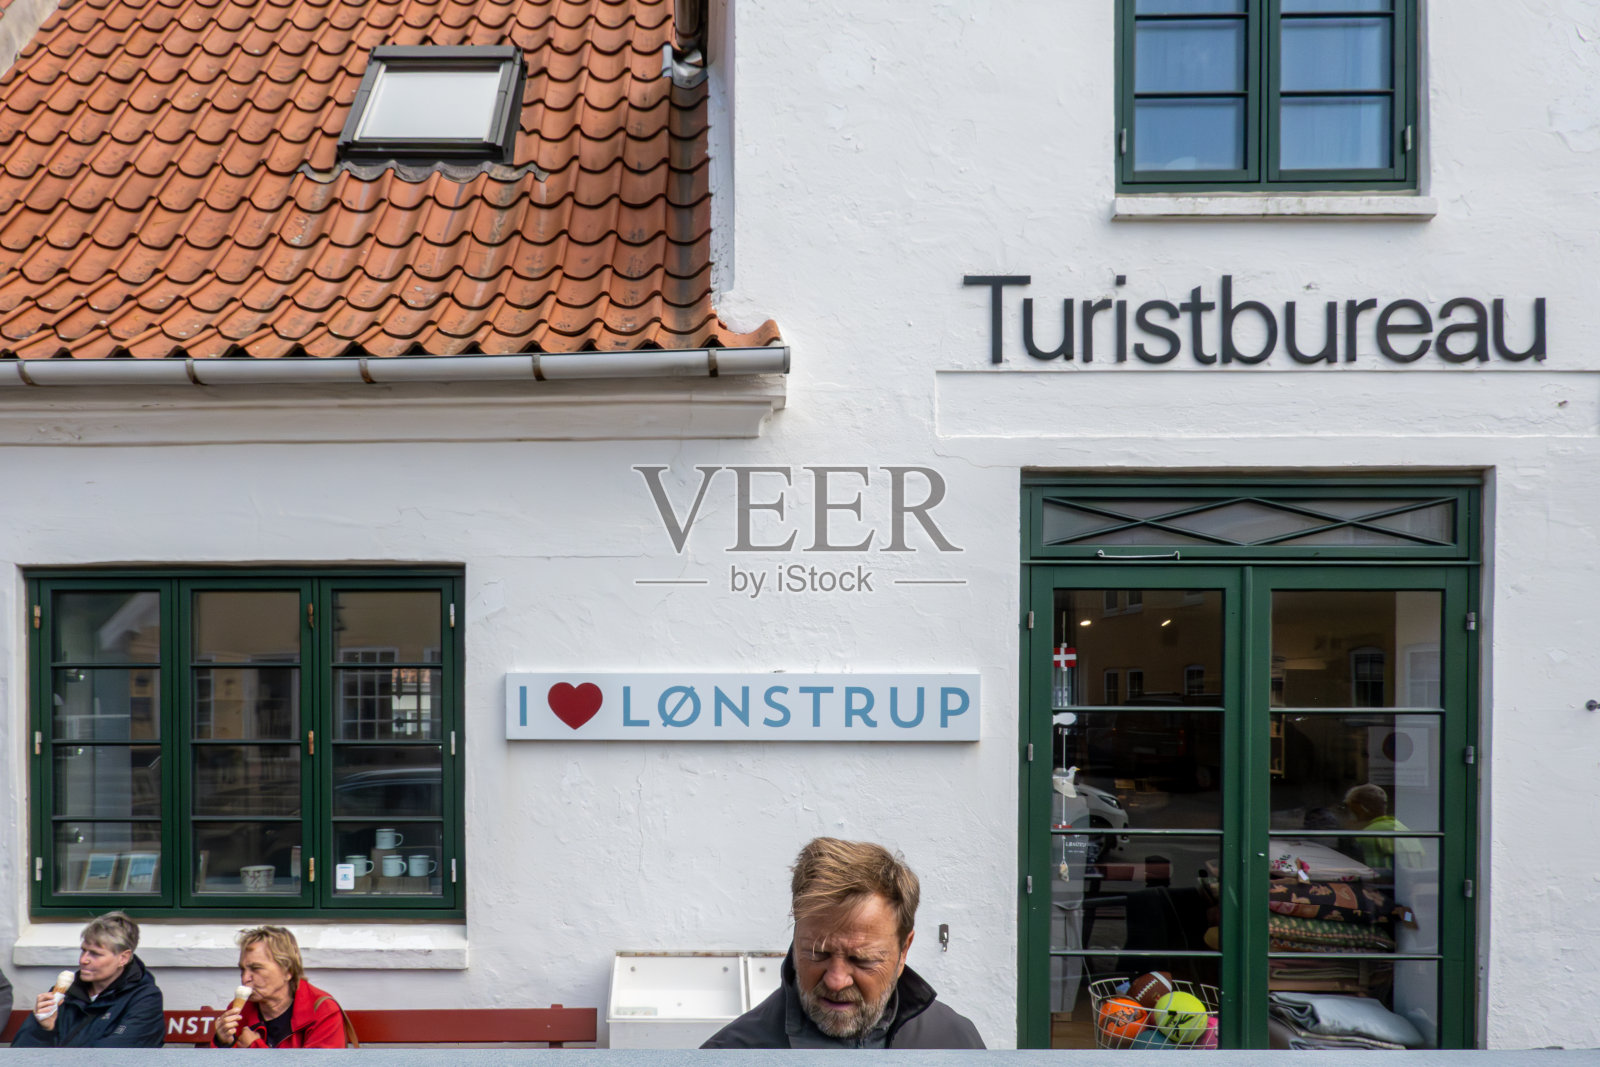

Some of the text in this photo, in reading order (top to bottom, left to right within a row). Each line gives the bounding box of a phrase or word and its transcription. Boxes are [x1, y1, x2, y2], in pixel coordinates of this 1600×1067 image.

[964, 275, 1546, 364] Turistbureau
[519, 685, 971, 729] I LØNSTRUP
[167, 1016, 215, 1035] NST
